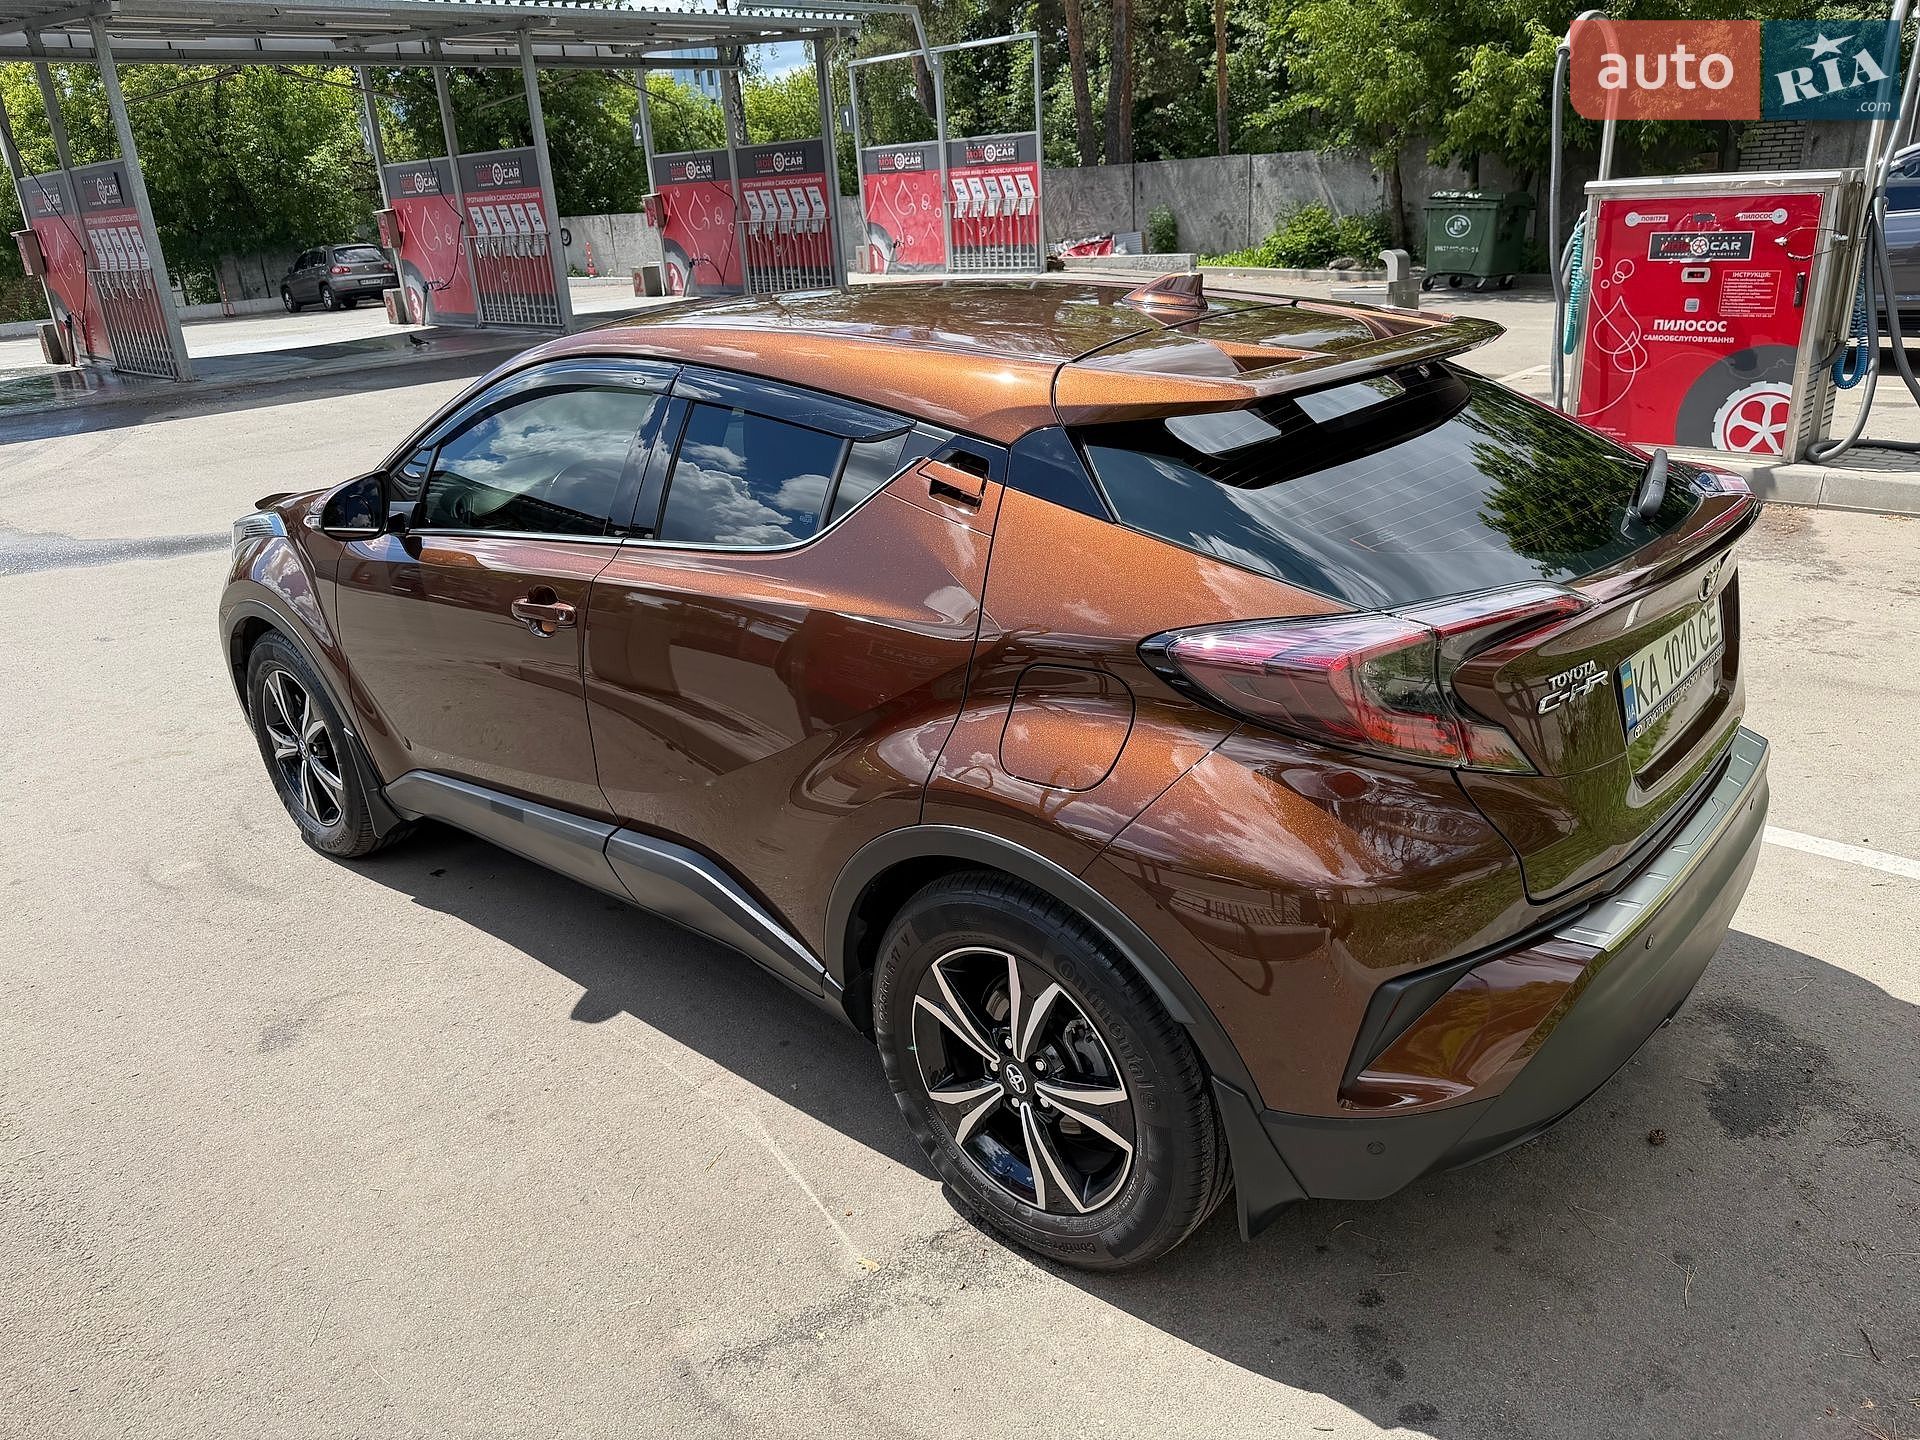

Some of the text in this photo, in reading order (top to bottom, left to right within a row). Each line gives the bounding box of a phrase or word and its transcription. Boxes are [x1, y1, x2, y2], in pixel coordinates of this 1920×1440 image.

[844, 111, 850, 127] 1
[364, 126, 371, 146] 3
[634, 123, 641, 139] 2
[996, 147, 1015, 157] CAR
[785, 156, 803, 166] CAR
[904, 156, 921, 165] CAR
[503, 168, 520, 179] CAR
[696, 165, 712, 174] CAR
[1641, 214, 1667, 222] ПОВІТРЯ
[1740, 212, 1773, 220] ПИЛОСОС
[1710, 241, 1741, 250] CAR
[1653, 319, 1727, 332] ПИЛОСОС
[1643, 333, 1735, 344] САМООБСЛУГОВУВАННЯ
[1633, 653, 1662, 715] KA
[1663, 619, 1697, 685] 1010
[1699, 600, 1719, 651] CE
[1547, 659, 1598, 691] TOYOTA
[1538, 670, 1609, 715] C-HR
